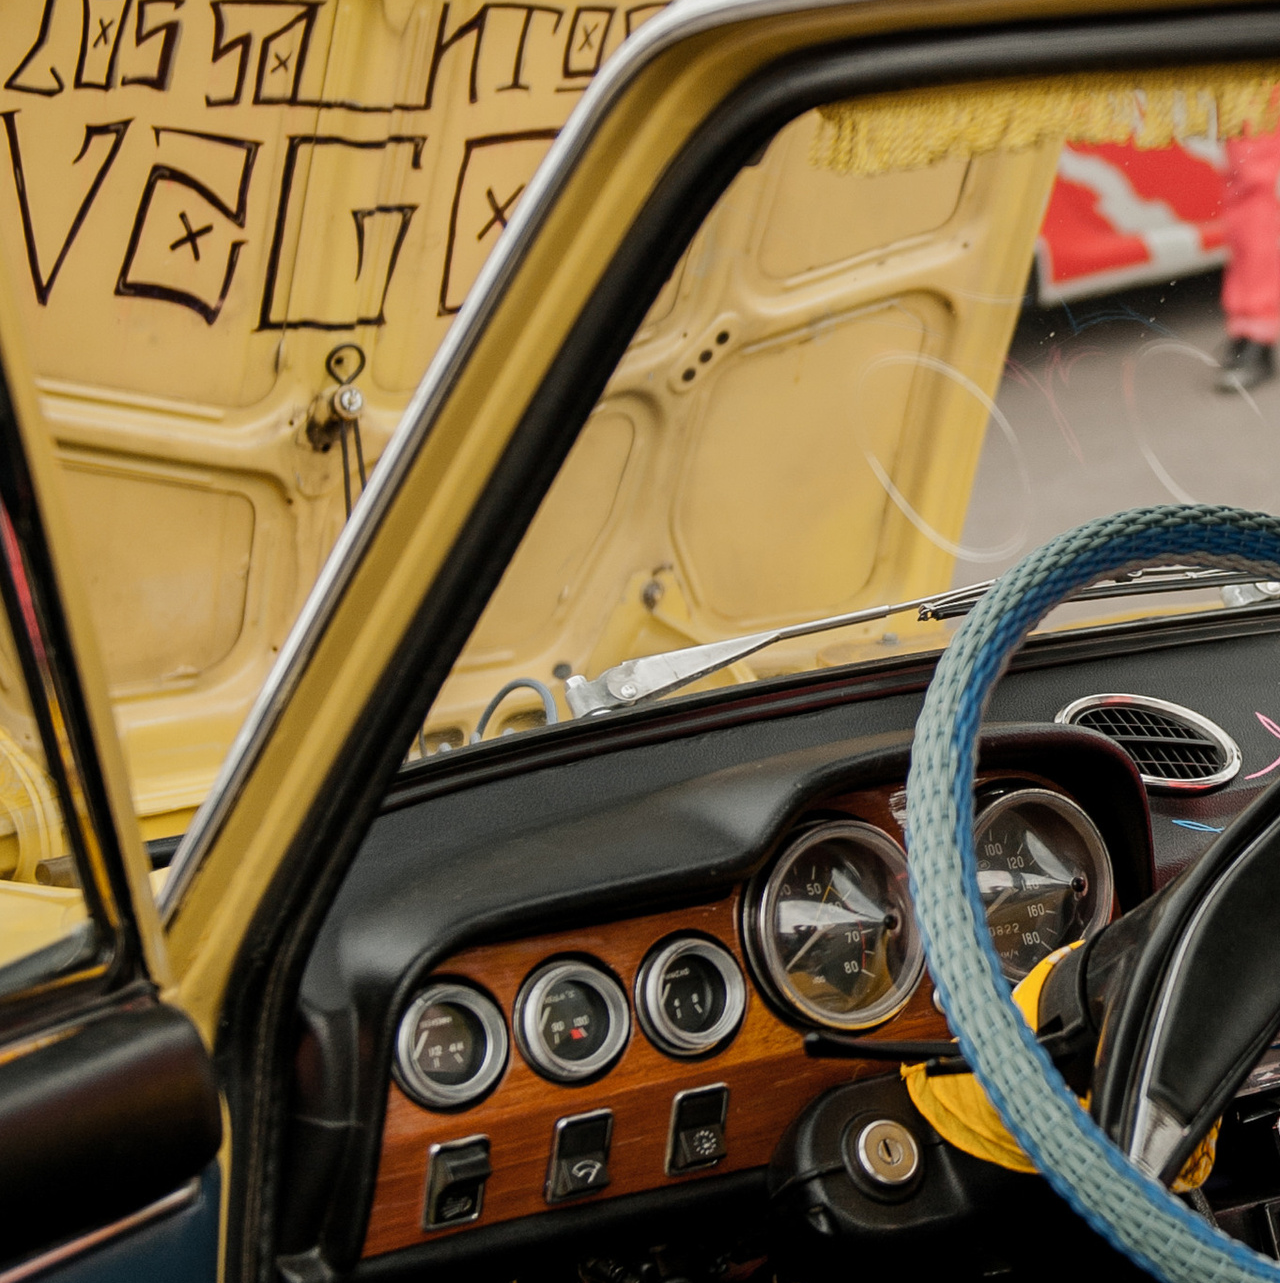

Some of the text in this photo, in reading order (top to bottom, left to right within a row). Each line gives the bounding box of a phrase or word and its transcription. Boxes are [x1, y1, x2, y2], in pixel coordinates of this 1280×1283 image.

[985, 843, 1003, 857] 100
[1006, 856, 1025, 870] 120
[806, 883, 822, 896] 50
[1027, 904, 1045, 918] 160
[845, 931, 860, 944] 70
[1022, 931, 1041, 946] 180
[844, 960, 859, 974] 80
